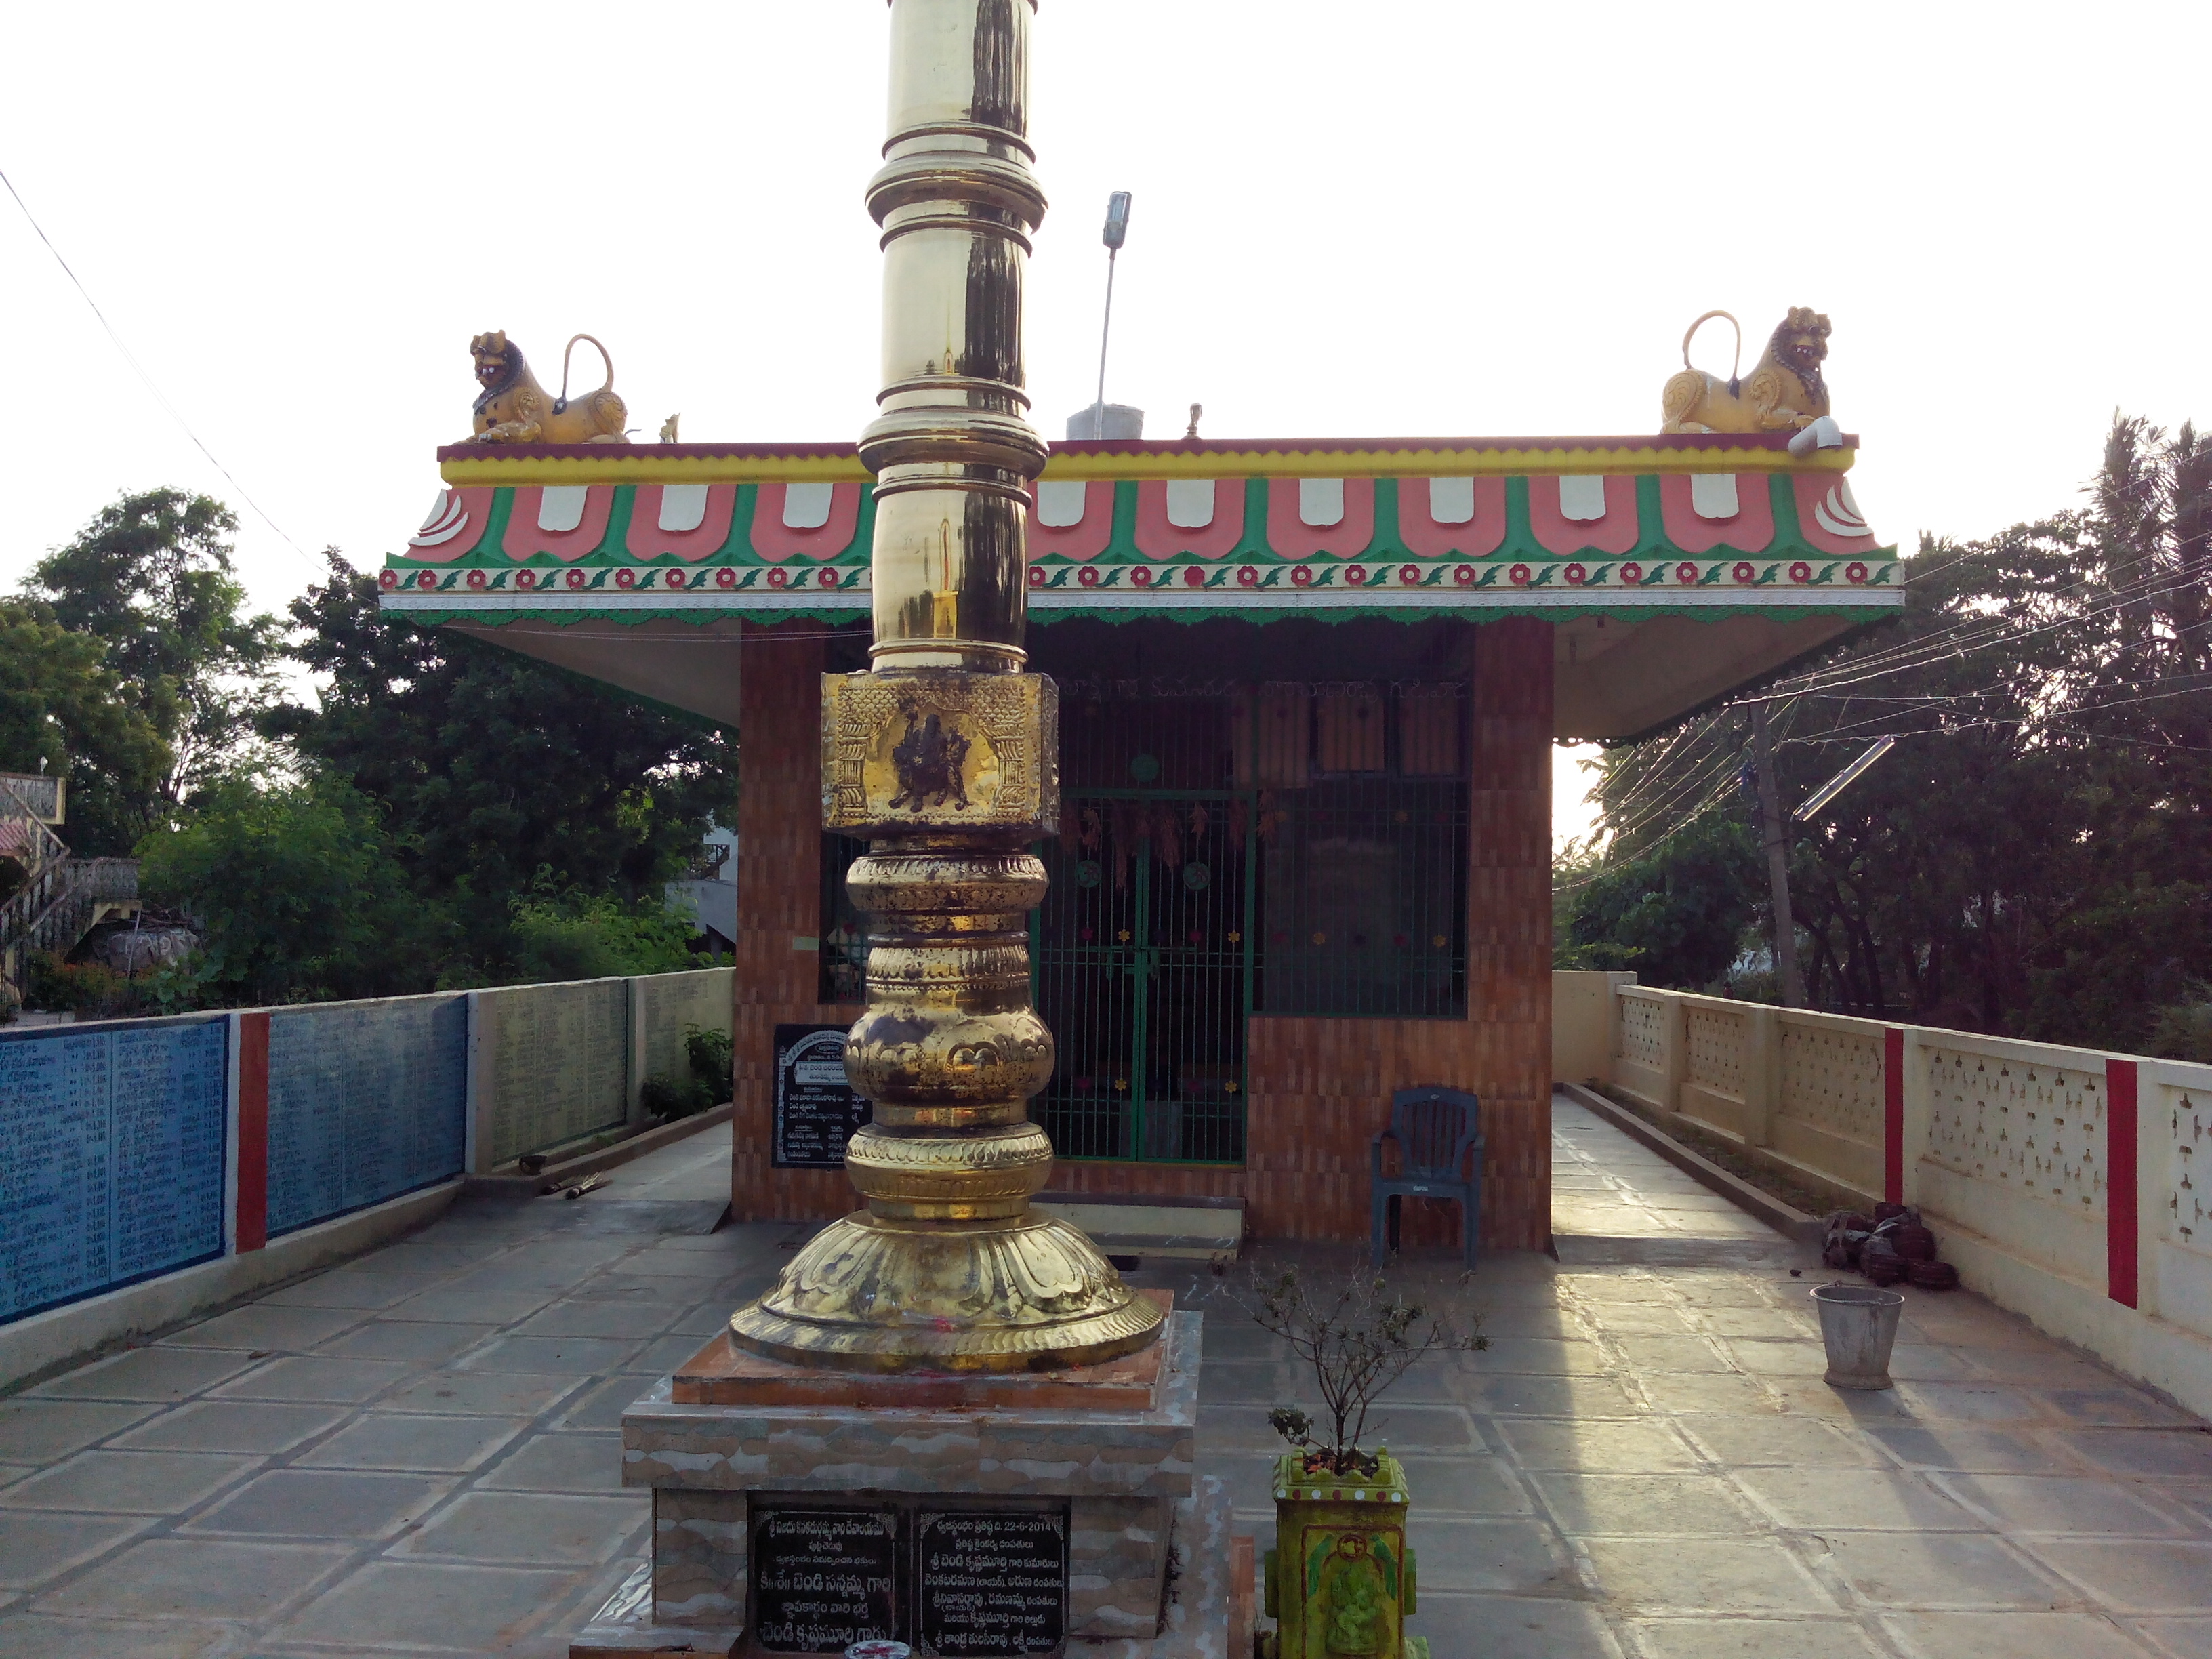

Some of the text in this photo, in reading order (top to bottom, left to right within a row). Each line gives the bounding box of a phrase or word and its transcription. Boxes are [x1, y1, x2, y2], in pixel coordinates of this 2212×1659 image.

[1004, 1521, 1051, 1532] 22-6-2014
[999, 1539, 1034, 1549] దంపతులు
[930, 1551, 1059, 1572] శ్రీ బెండి కృష్ణమూర్తి గారి కుమారులు
[793, 1572, 823, 1591] బెండి
[825, 1574, 865, 1601] సన్నమ్మ
[867, 1576, 891, 1593] గారి
[925, 1572, 975, 1586] వెంకటరమణ
[1008, 1574, 1032, 1588] అరుణ
[830, 1603, 851, 1614] వారి
[988, 1593, 1026, 1611] రమణమ్మ
[944, 1613, 969, 1623] మరియు
[970, 1611, 1010, 1629] కృష్ణమూర్తి
[1010, 1614, 1023, 1624] గారి
[935, 1629, 943, 1647] శ్రీ
